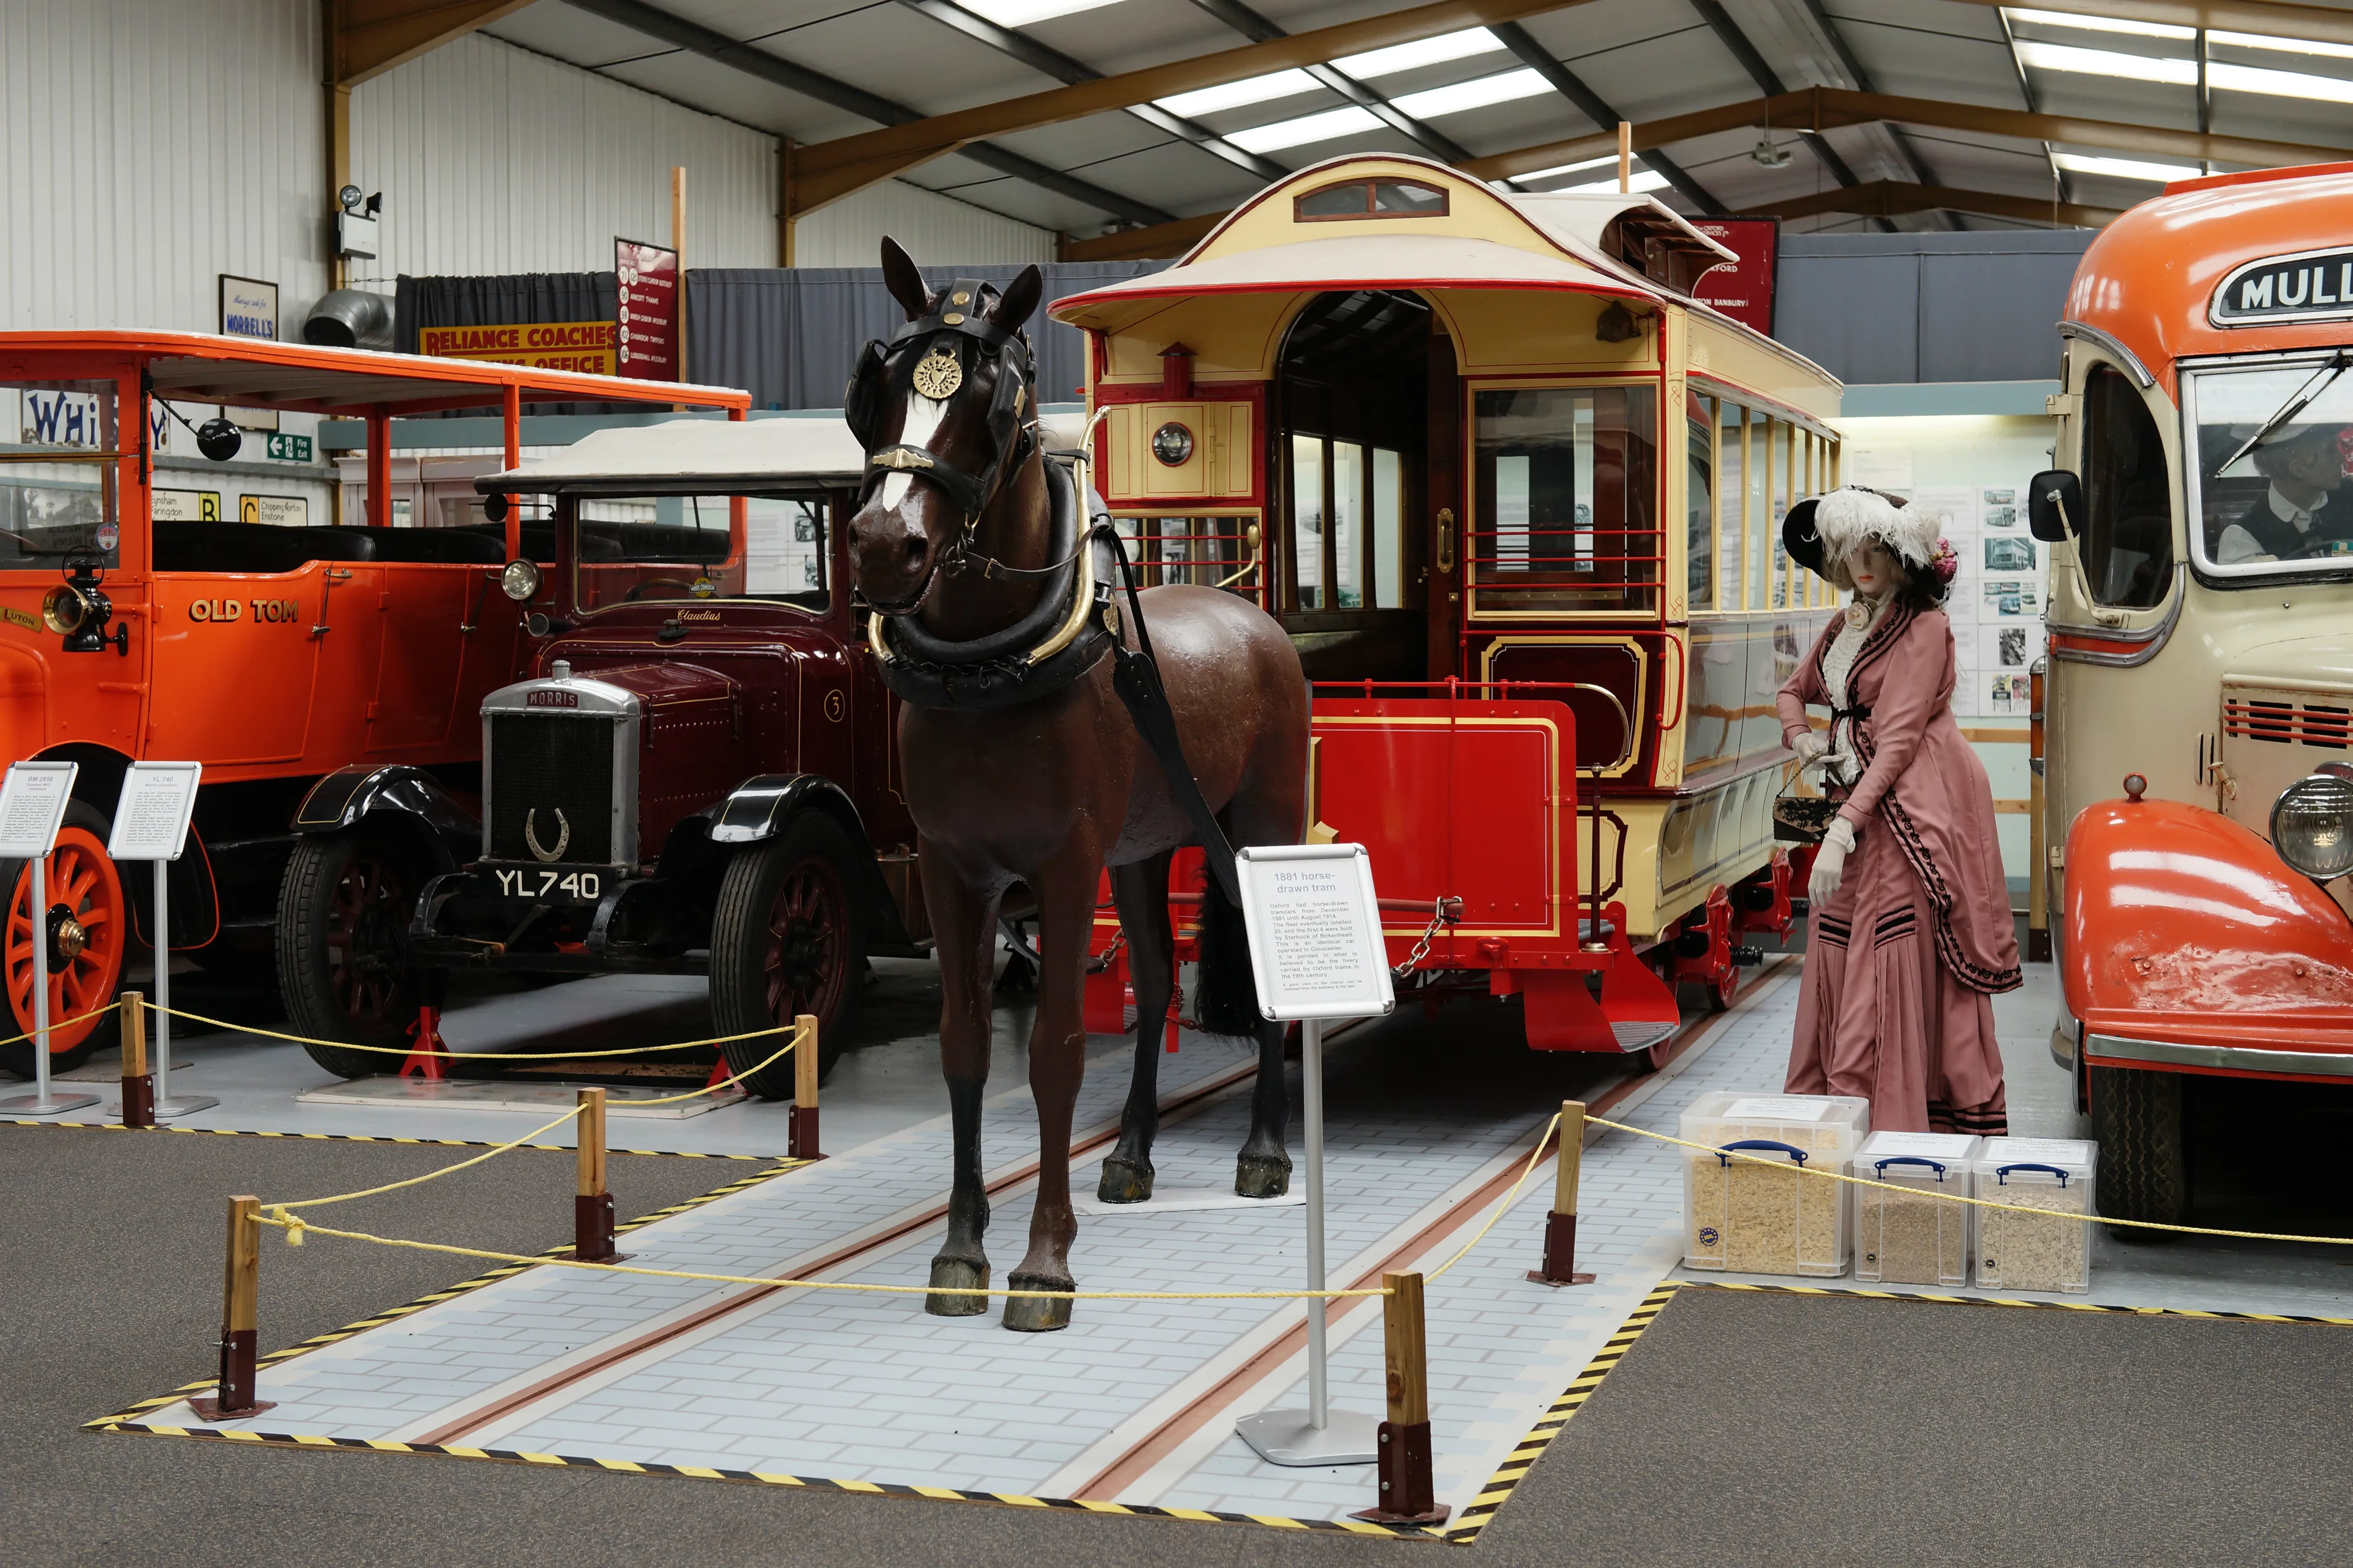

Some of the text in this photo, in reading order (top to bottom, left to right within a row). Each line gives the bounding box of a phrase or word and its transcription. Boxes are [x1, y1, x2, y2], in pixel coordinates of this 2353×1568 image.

[1714, 298, 1745, 307] BANBURY
[426, 325, 616, 356] RELIANCE COACHES
[534, 356, 604, 373] OFFICE
[297, 439, 307, 448] Fire
[298, 449, 307, 458] Exit
[261, 502, 284, 513] Chipping
[284, 502, 301, 512] Norton
[261, 512, 284, 521] Enstone
[188, 599, 298, 622] OLD TOM
[678, 609, 721, 621] Claudius
[5, 609, 35, 626] LUTON
[531, 692, 575, 705] MORRIS
[832, 696, 839, 715] 3
[1274, 872, 1335, 881] 1881 horse-
